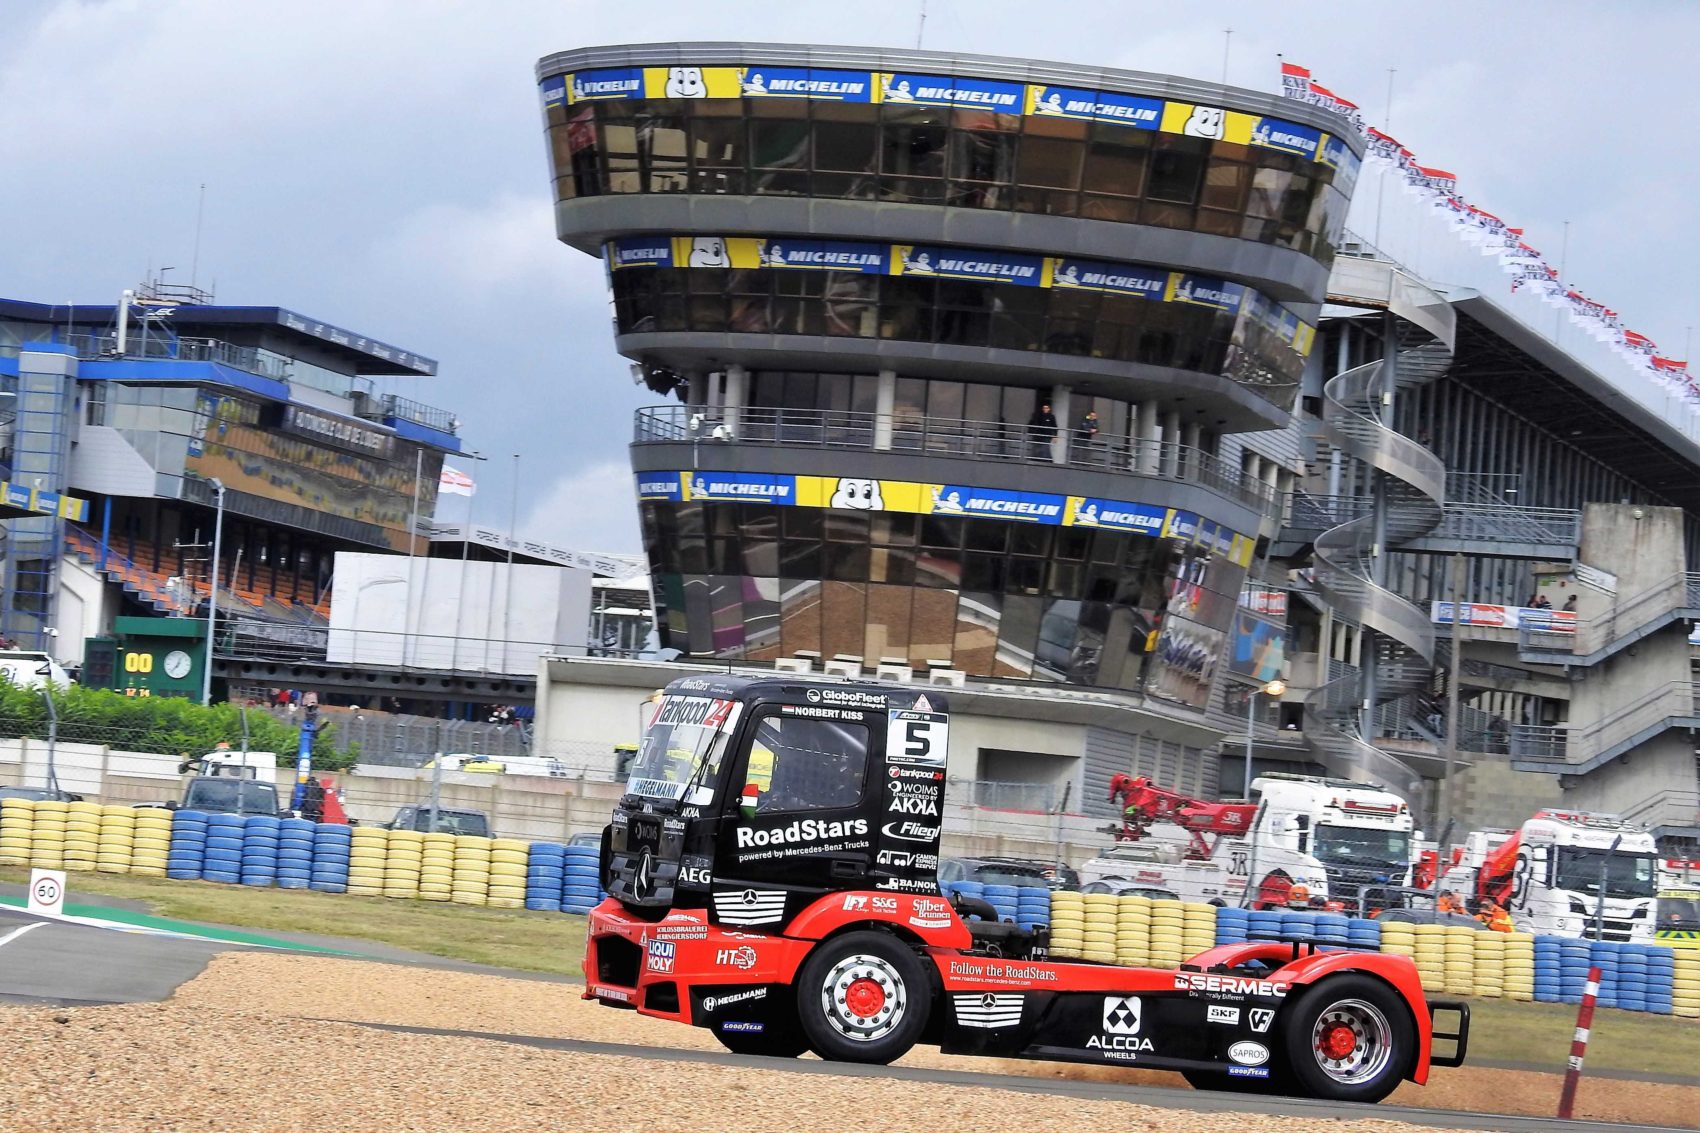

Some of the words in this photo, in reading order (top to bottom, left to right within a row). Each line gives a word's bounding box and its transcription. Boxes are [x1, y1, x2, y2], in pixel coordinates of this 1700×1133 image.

[584, 80, 640, 93] MICHELIN
[769, 79, 864, 94] MICHELIN
[916, 87, 1017, 105] MICHELIN
[1066, 100, 1158, 121] MICHELIN
[1271, 131, 1318, 152] MICHELIN
[788, 250, 881, 266] MICHELIN
[937, 259, 1035, 278] MICHELIN
[1082, 272, 1164, 292] MICHELIN
[709, 482, 789, 497] MICHELIN
[965, 498, 1060, 516] MICHELIN
[1101, 510, 1163, 529] MICHELIN
[125, 652, 153, 673] 00
[822, 690, 886, 704] GloboFleet
[794, 706, 839, 719] NORBERT
[841, 710, 863, 720] KISS
[905, 722, 930, 756] 5
[900, 768, 944, 780] tankpool24
[902, 782, 938, 795] WOIMS
[736, 818, 868, 848] RoadStars
[900, 821, 941, 839] Fliegl
[739, 851, 772, 863] powered
[774, 850, 783, 859] by
[785, 844, 842, 857] Mercedes-Benz
[844, 840, 869, 849] Trucks
[678, 866, 711, 883] AEG
[38, 885, 56, 898] 60
[872, 897, 897, 908] S&G
[913, 898, 945, 911] Silber
[918, 909, 950, 919] Brunnen
[648, 955, 673, 972] MOLY
[716, 949, 738, 965] HT
[950, 961, 983, 976] Follow
[986, 964, 1002, 976] the
[1005, 966, 1058, 980] RoadStars.
[718, 987, 767, 1005] HEGELMANN
[1211, 1008, 1237, 1017] SKF
[723, 1023, 763, 1031] GOODYEAR
[1085, 1034, 1154, 1051] ALCOA
[1104, 1051, 1136, 1060] WHEELS
[1233, 1048, 1265, 1059] SAPROS
[1229, 1067, 1268, 1076] GOODYEAR
